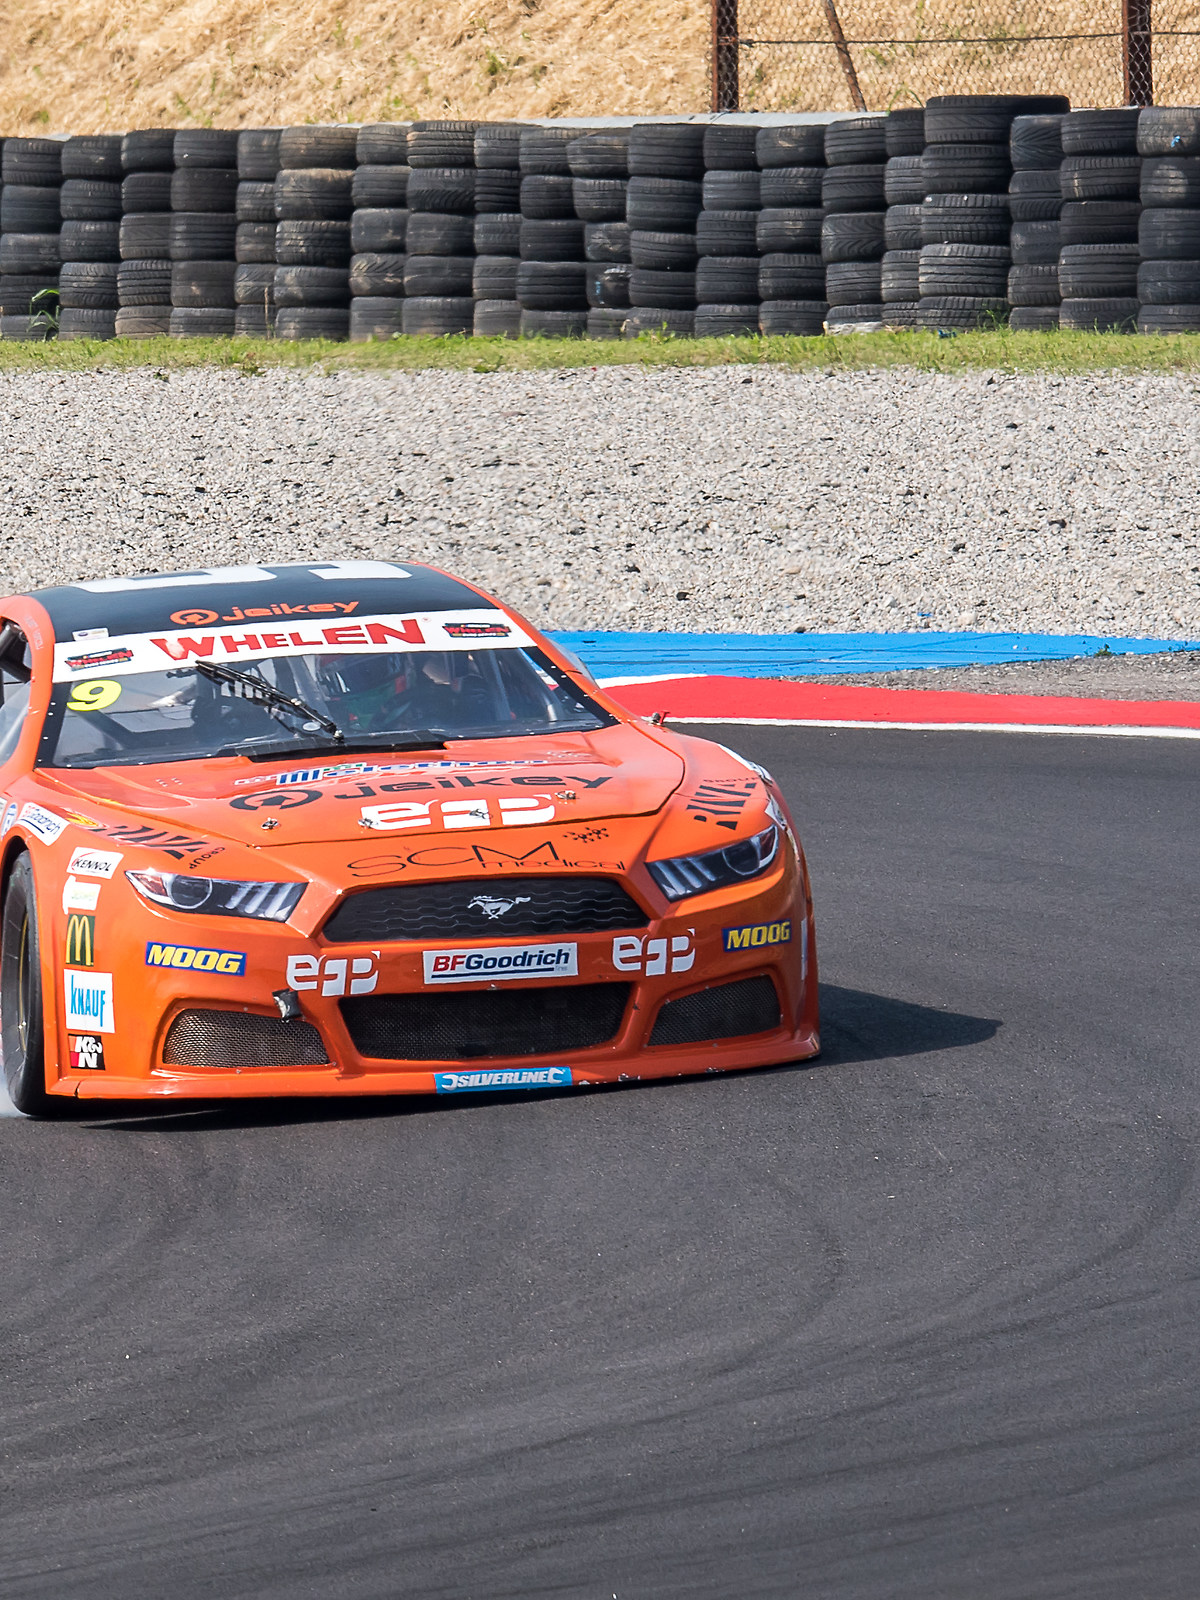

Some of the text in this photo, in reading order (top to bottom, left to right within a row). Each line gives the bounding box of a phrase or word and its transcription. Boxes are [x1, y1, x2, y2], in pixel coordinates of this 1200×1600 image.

[222, 600, 360, 622] jeikey
[150, 618, 426, 661] WHELEN
[67, 679, 122, 711] 9
[334, 775, 614, 799] jeikey
[73, 858, 112, 872] KENNOL
[347, 840, 626, 878] SCM medical
[727, 920, 791, 949] MOOG
[147, 944, 244, 974] MOOG
[432, 948, 570, 973] BFGoodrich
[70, 974, 106, 1028] KNAUF
